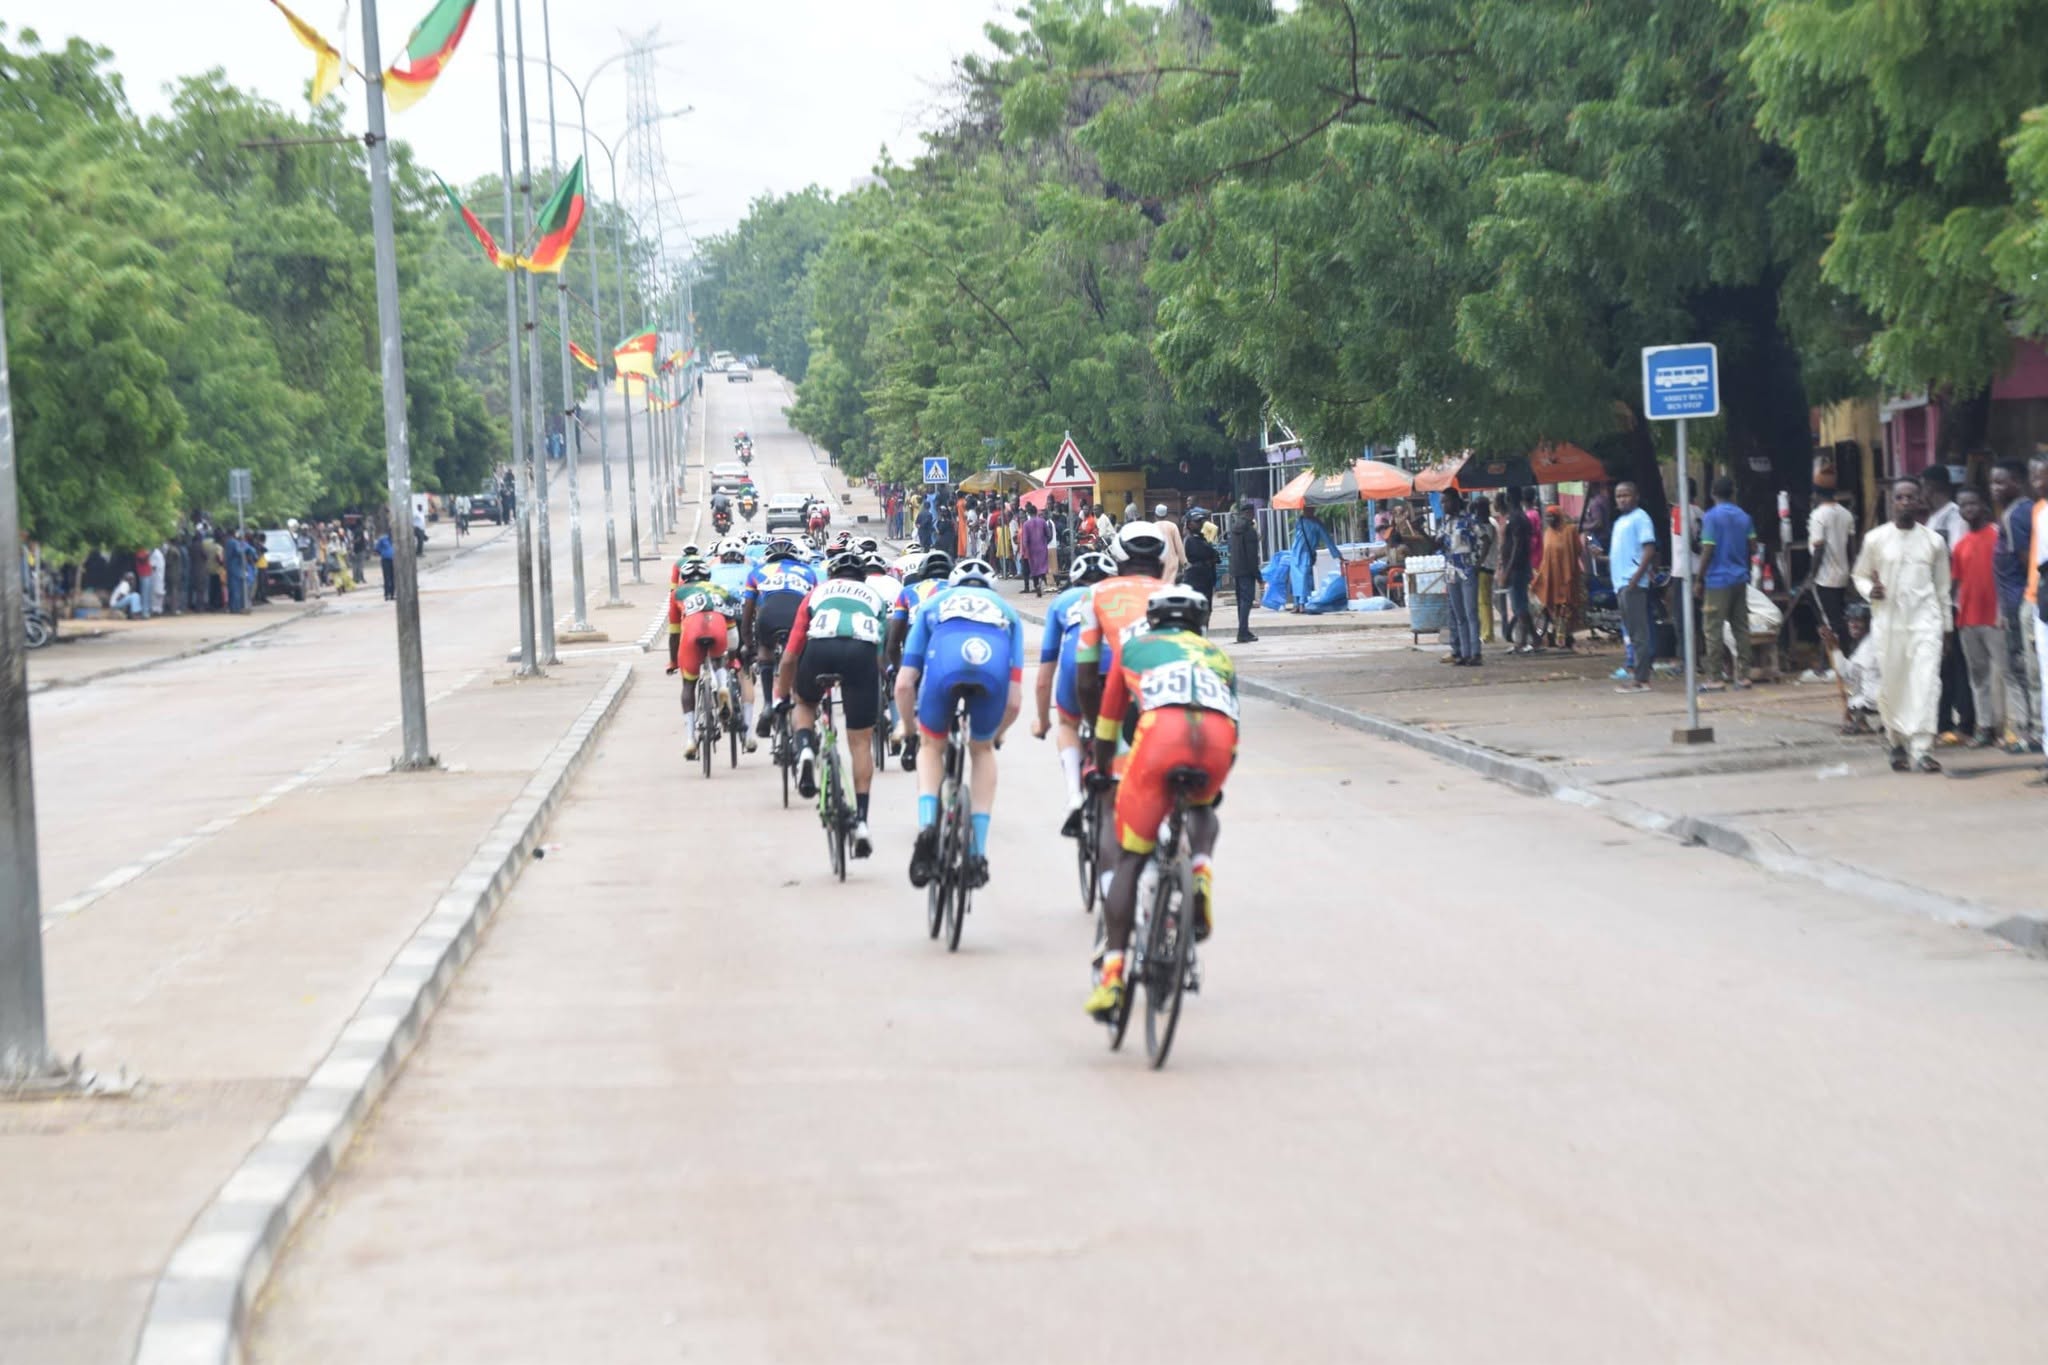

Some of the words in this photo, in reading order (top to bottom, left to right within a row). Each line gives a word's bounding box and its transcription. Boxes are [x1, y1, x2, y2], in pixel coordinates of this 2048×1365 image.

[823, 585, 873, 603] ALGERIA
[943, 596, 990, 615] 232
[815, 614, 828, 630] 4
[863, 619, 875, 635] 4
[1141, 667, 1187, 696] 55
